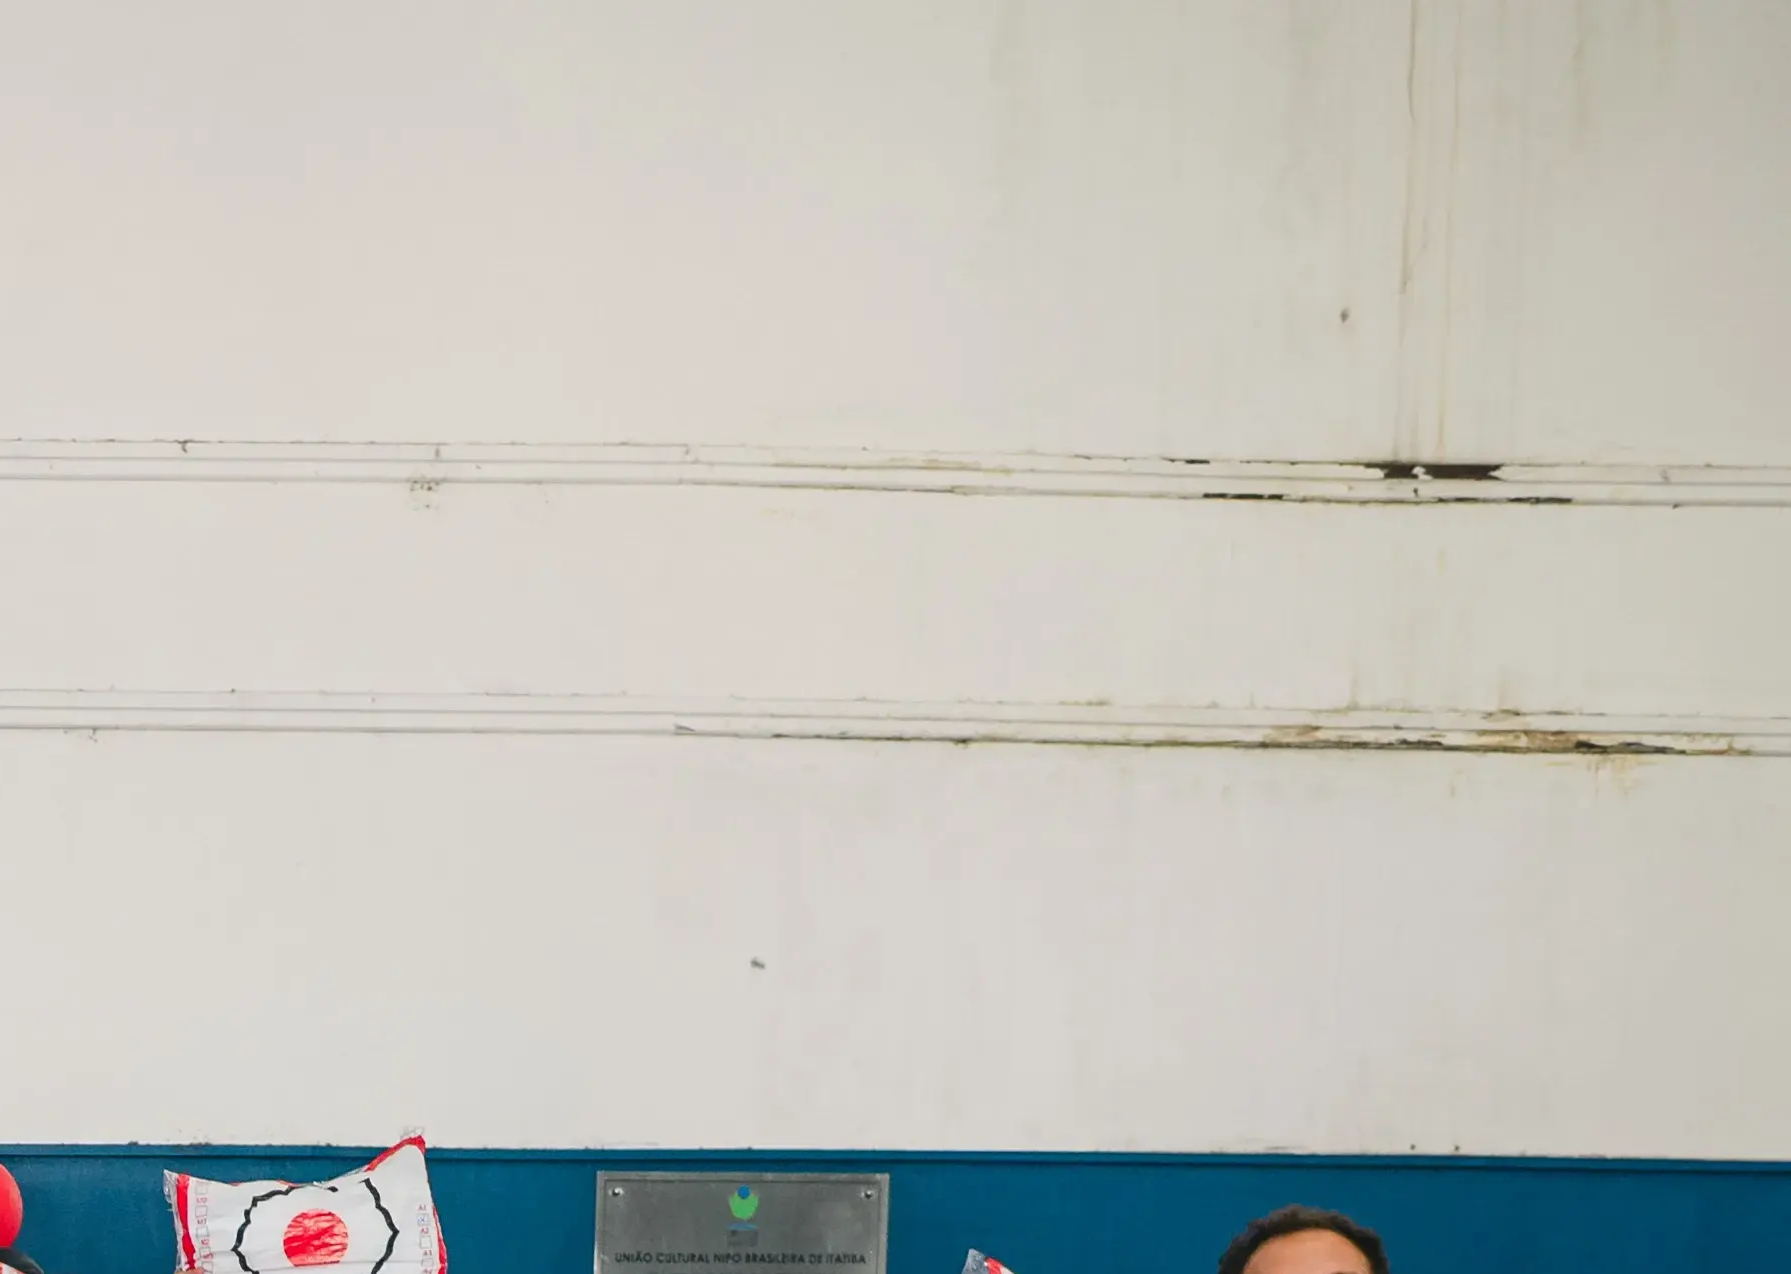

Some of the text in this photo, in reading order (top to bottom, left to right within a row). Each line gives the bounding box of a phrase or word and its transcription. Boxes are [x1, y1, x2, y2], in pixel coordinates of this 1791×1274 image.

[615, 1251, 653, 1264] UNIÃO
[656, 1253, 709, 1264] CULTURAL
[745, 1253, 806, 1264] BRASILEIRA
